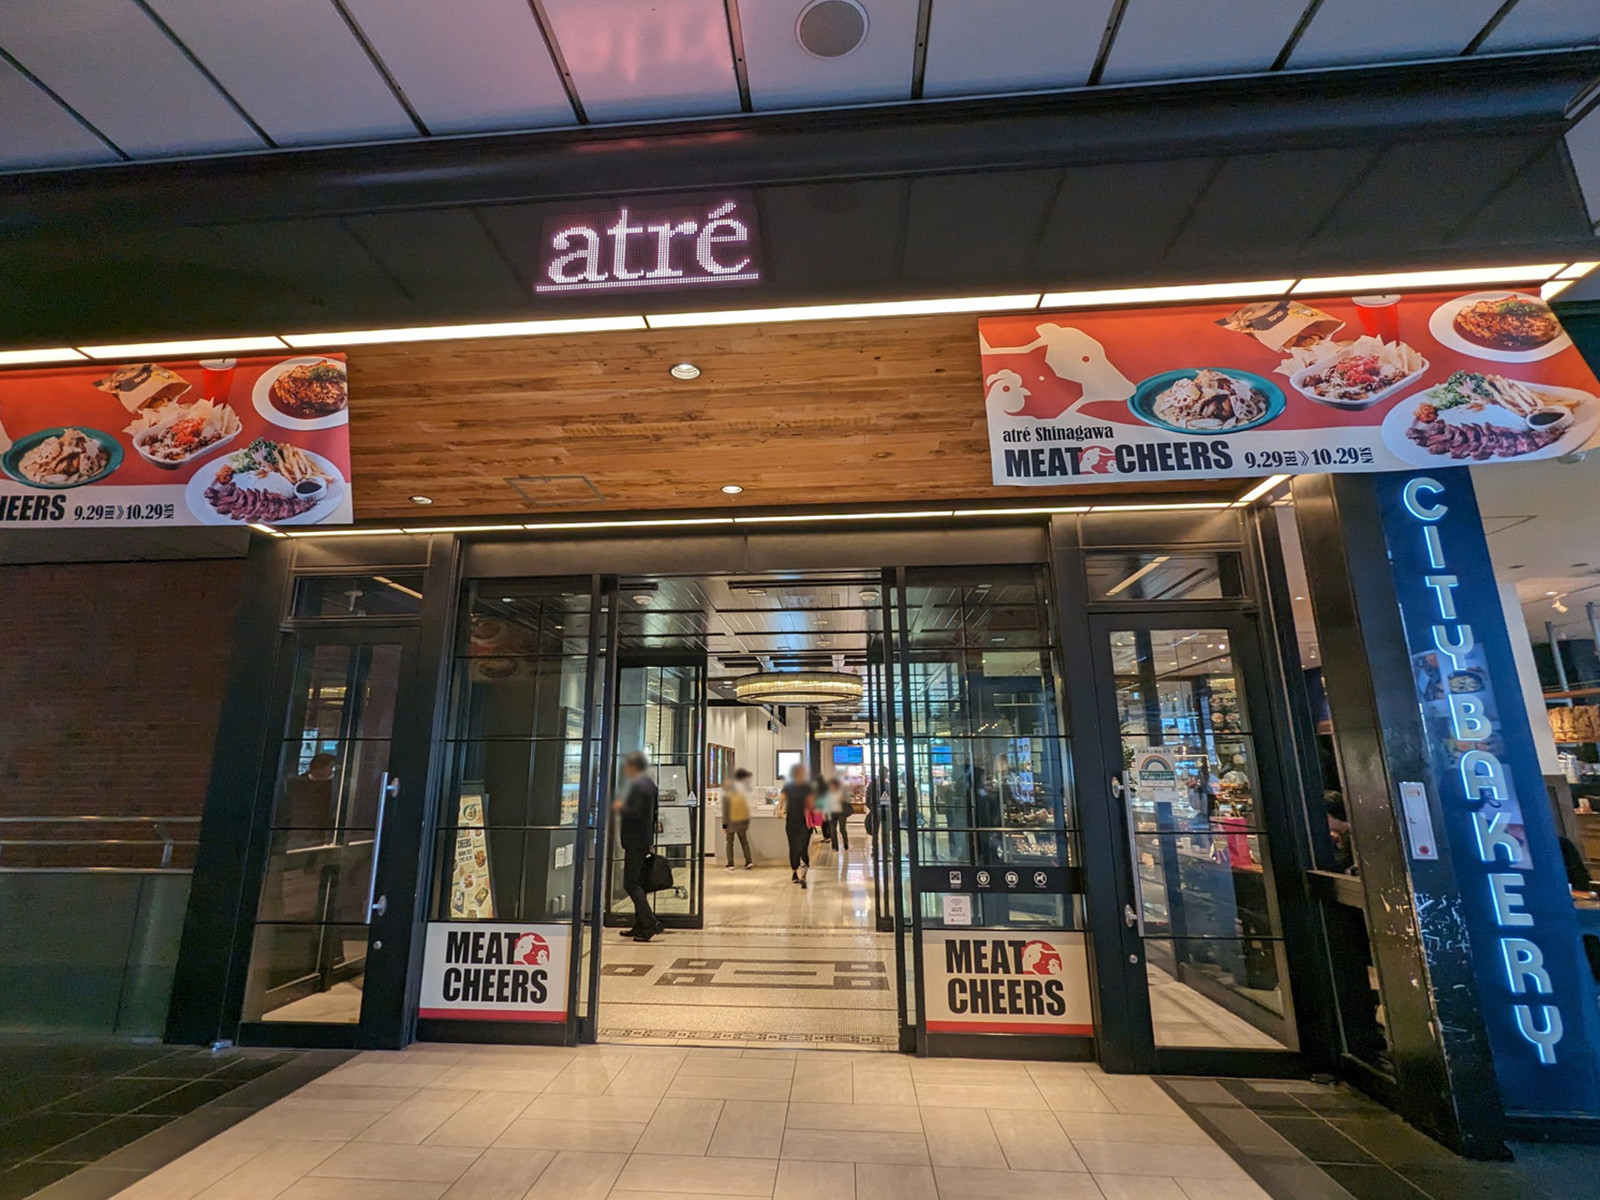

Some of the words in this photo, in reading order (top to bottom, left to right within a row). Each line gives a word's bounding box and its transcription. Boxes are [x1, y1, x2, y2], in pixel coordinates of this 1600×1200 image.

[548, 201, 750, 284] atré
[1003, 427, 1032, 443] atré
[1035, 425, 1114, 442] Shinagawa
[1004, 447, 1083, 477] MEAT
[1115, 440, 1233, 474] CHEERS
[1402, 476, 1475, 672] CITY
[1447, 692, 1565, 1065] BAKERY
[445, 931, 521, 965] MEAT
[945, 939, 1027, 975] MEAT
[442, 967, 549, 1004] CHEERS
[947, 977, 1066, 1016] CHEERS
